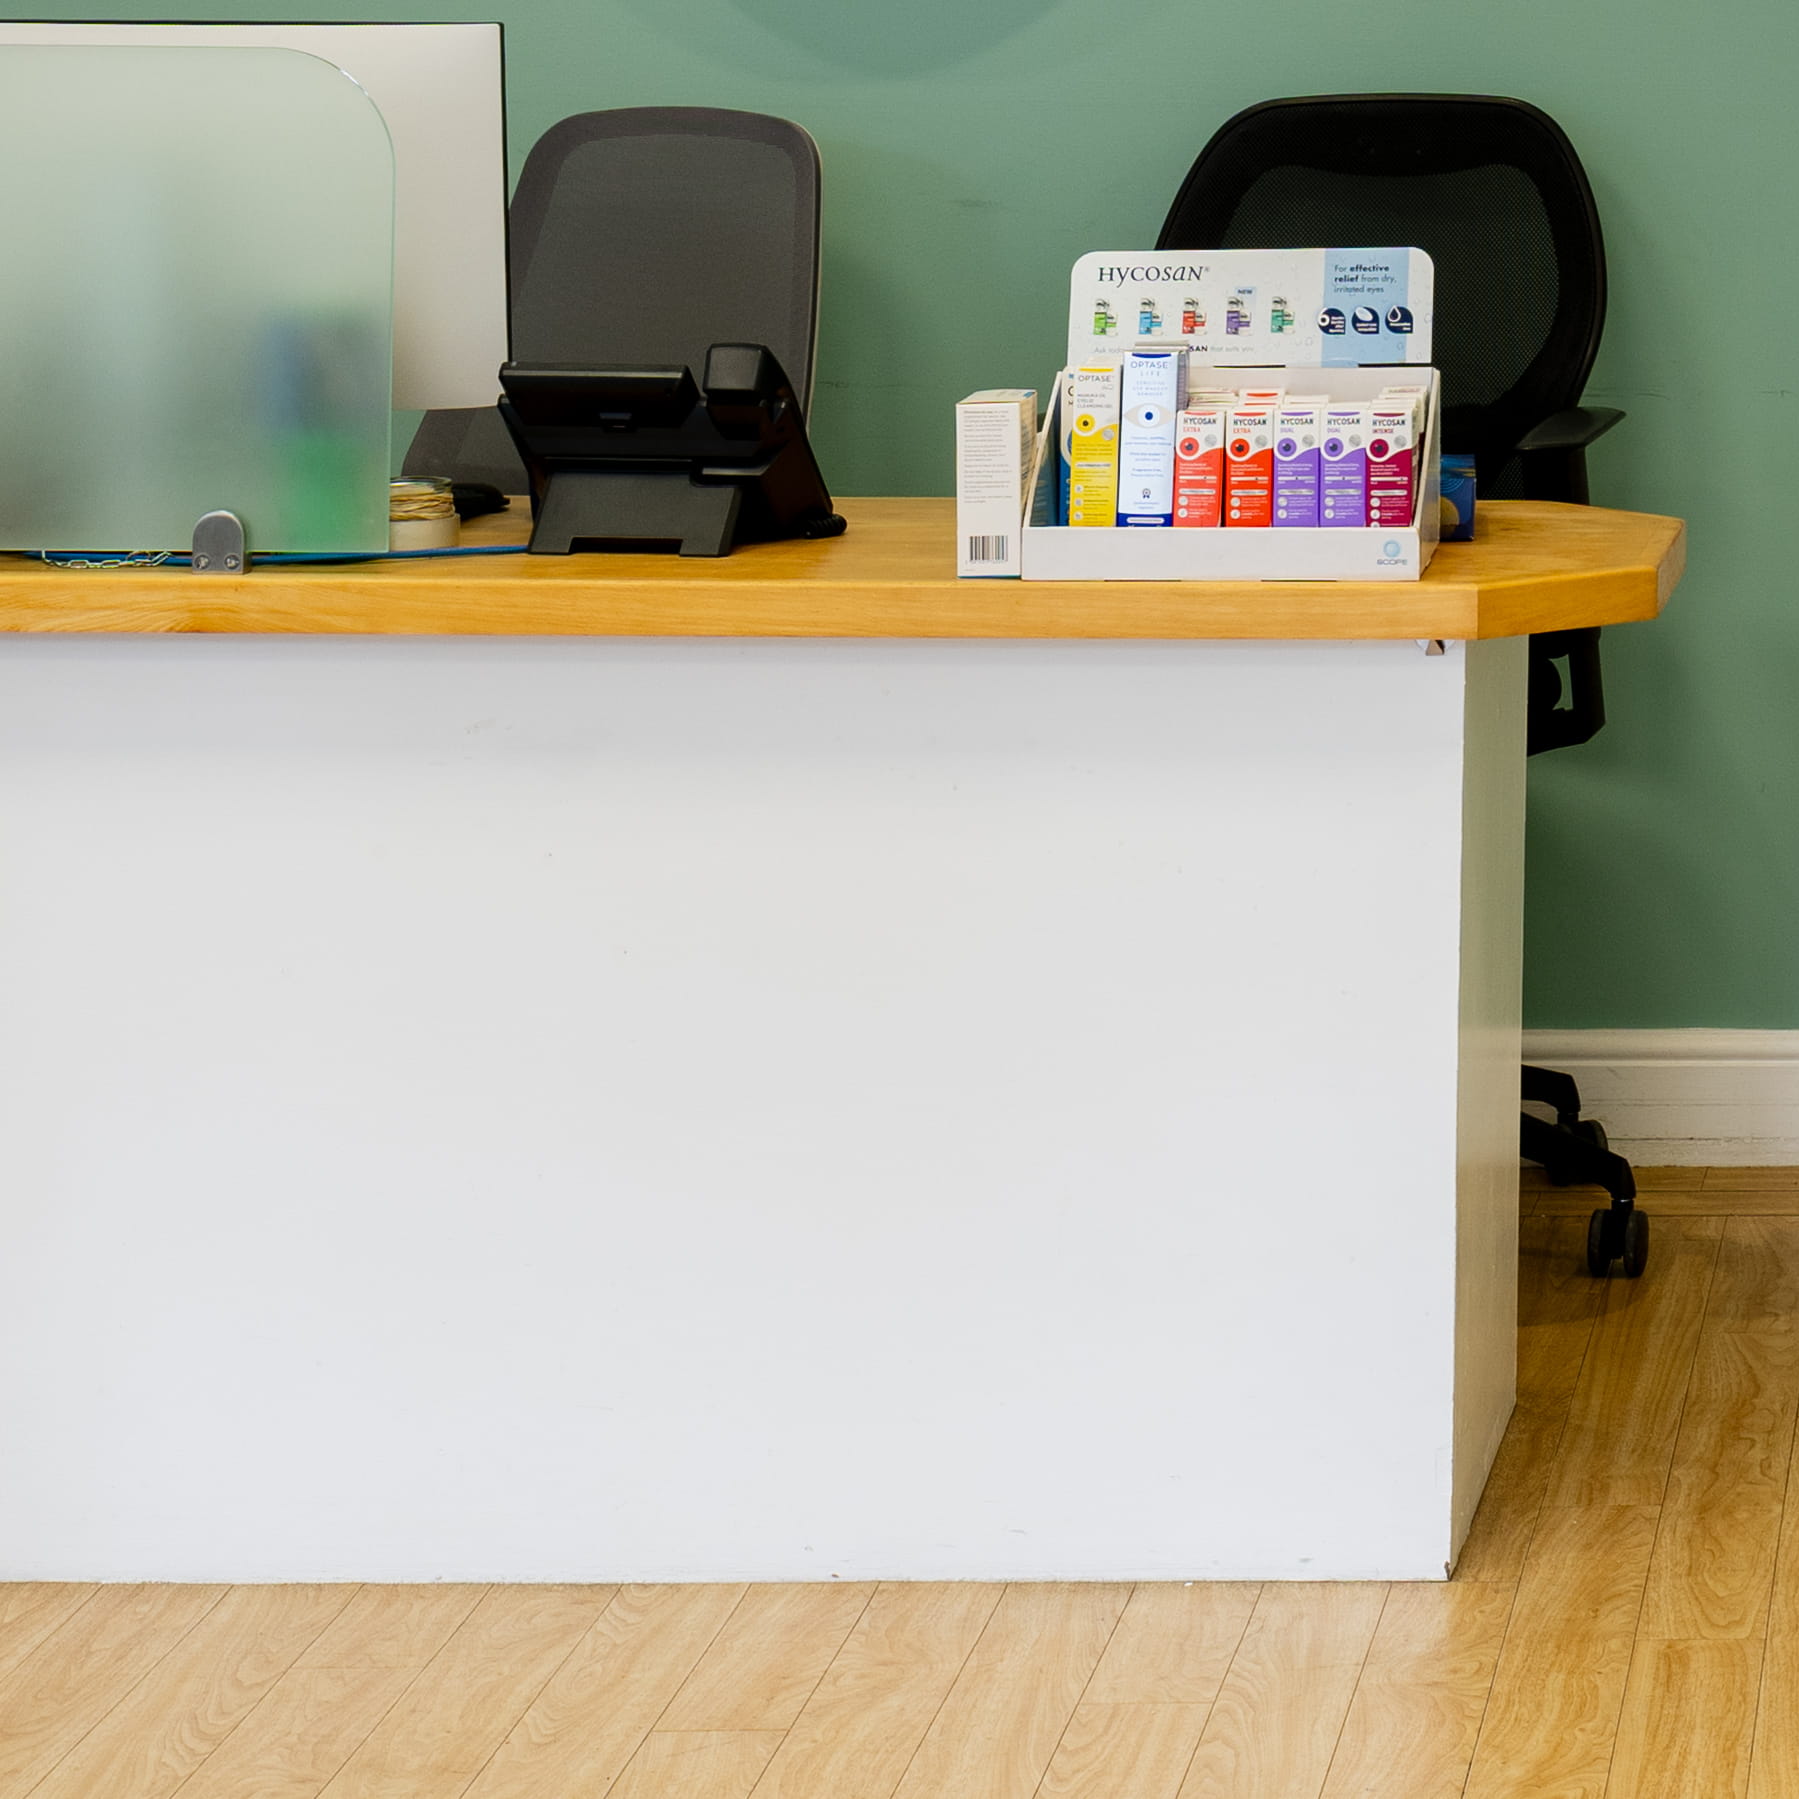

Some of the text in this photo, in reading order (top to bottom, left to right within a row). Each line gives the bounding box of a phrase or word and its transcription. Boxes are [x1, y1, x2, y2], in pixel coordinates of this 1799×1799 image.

[1334, 263, 1390, 272] For effective
[1334, 274, 1360, 283] relief
[1361, 274, 1380, 283] from
[1333, 285, 1385, 295] irritated eyes
[1129, 360, 1169, 369] OPTASE
[1078, 374, 1112, 383] OPTASE
[1183, 417, 1217, 425] HYCOSAN
[1232, 418, 1267, 426] HYCOSAN
[1280, 417, 1314, 426] HYCOSAN
[1327, 417, 1361, 426] HYCOSAN
[1372, 418, 1406, 427] HYCOSAN
[1376, 558, 1408, 566] SCOPE
